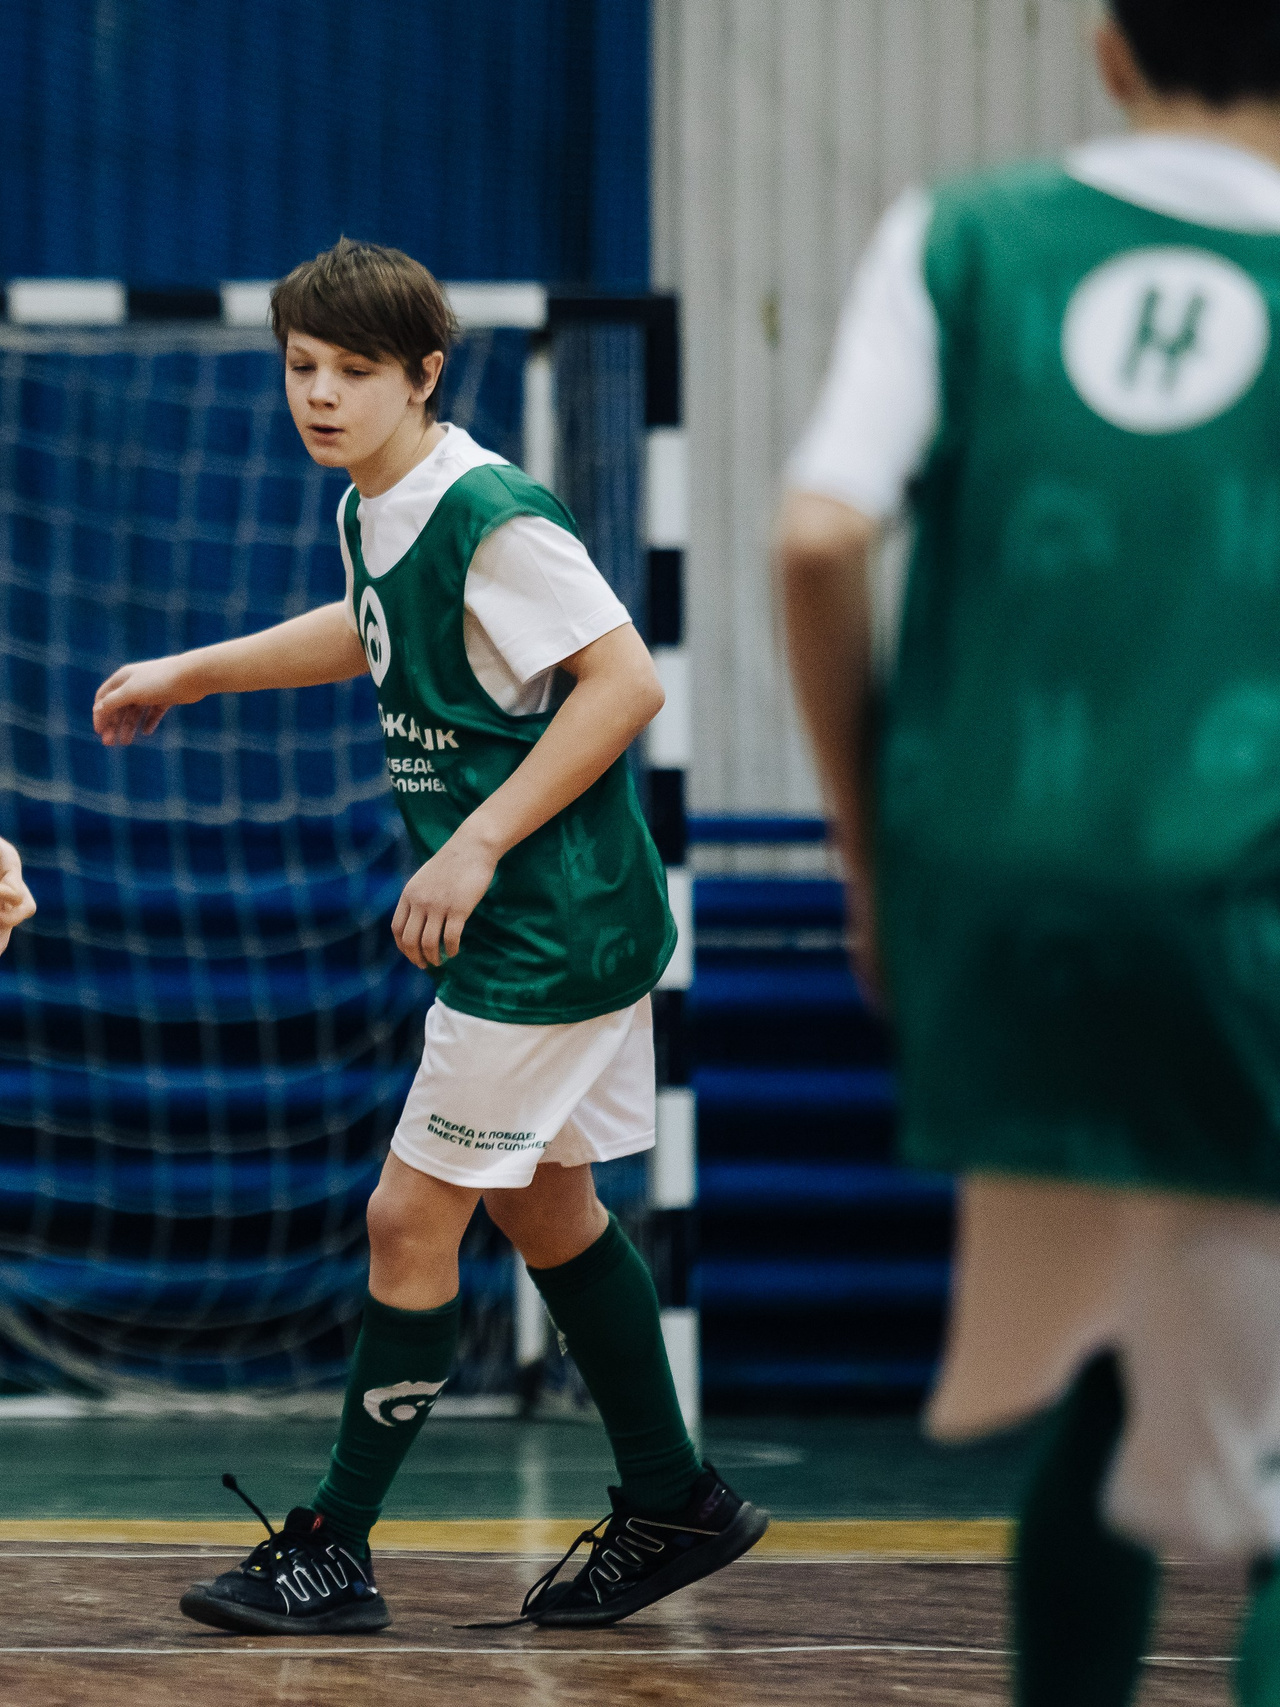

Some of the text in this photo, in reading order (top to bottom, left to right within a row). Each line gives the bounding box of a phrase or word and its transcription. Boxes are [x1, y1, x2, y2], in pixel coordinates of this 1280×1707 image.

[427, 1123, 472, 1148] ВМЕСТЕ
[474, 1141, 495, 1151] МЫ
[430, 1113, 475, 1139] ВПЕРЁД
[478, 1131, 487, 1139] К
